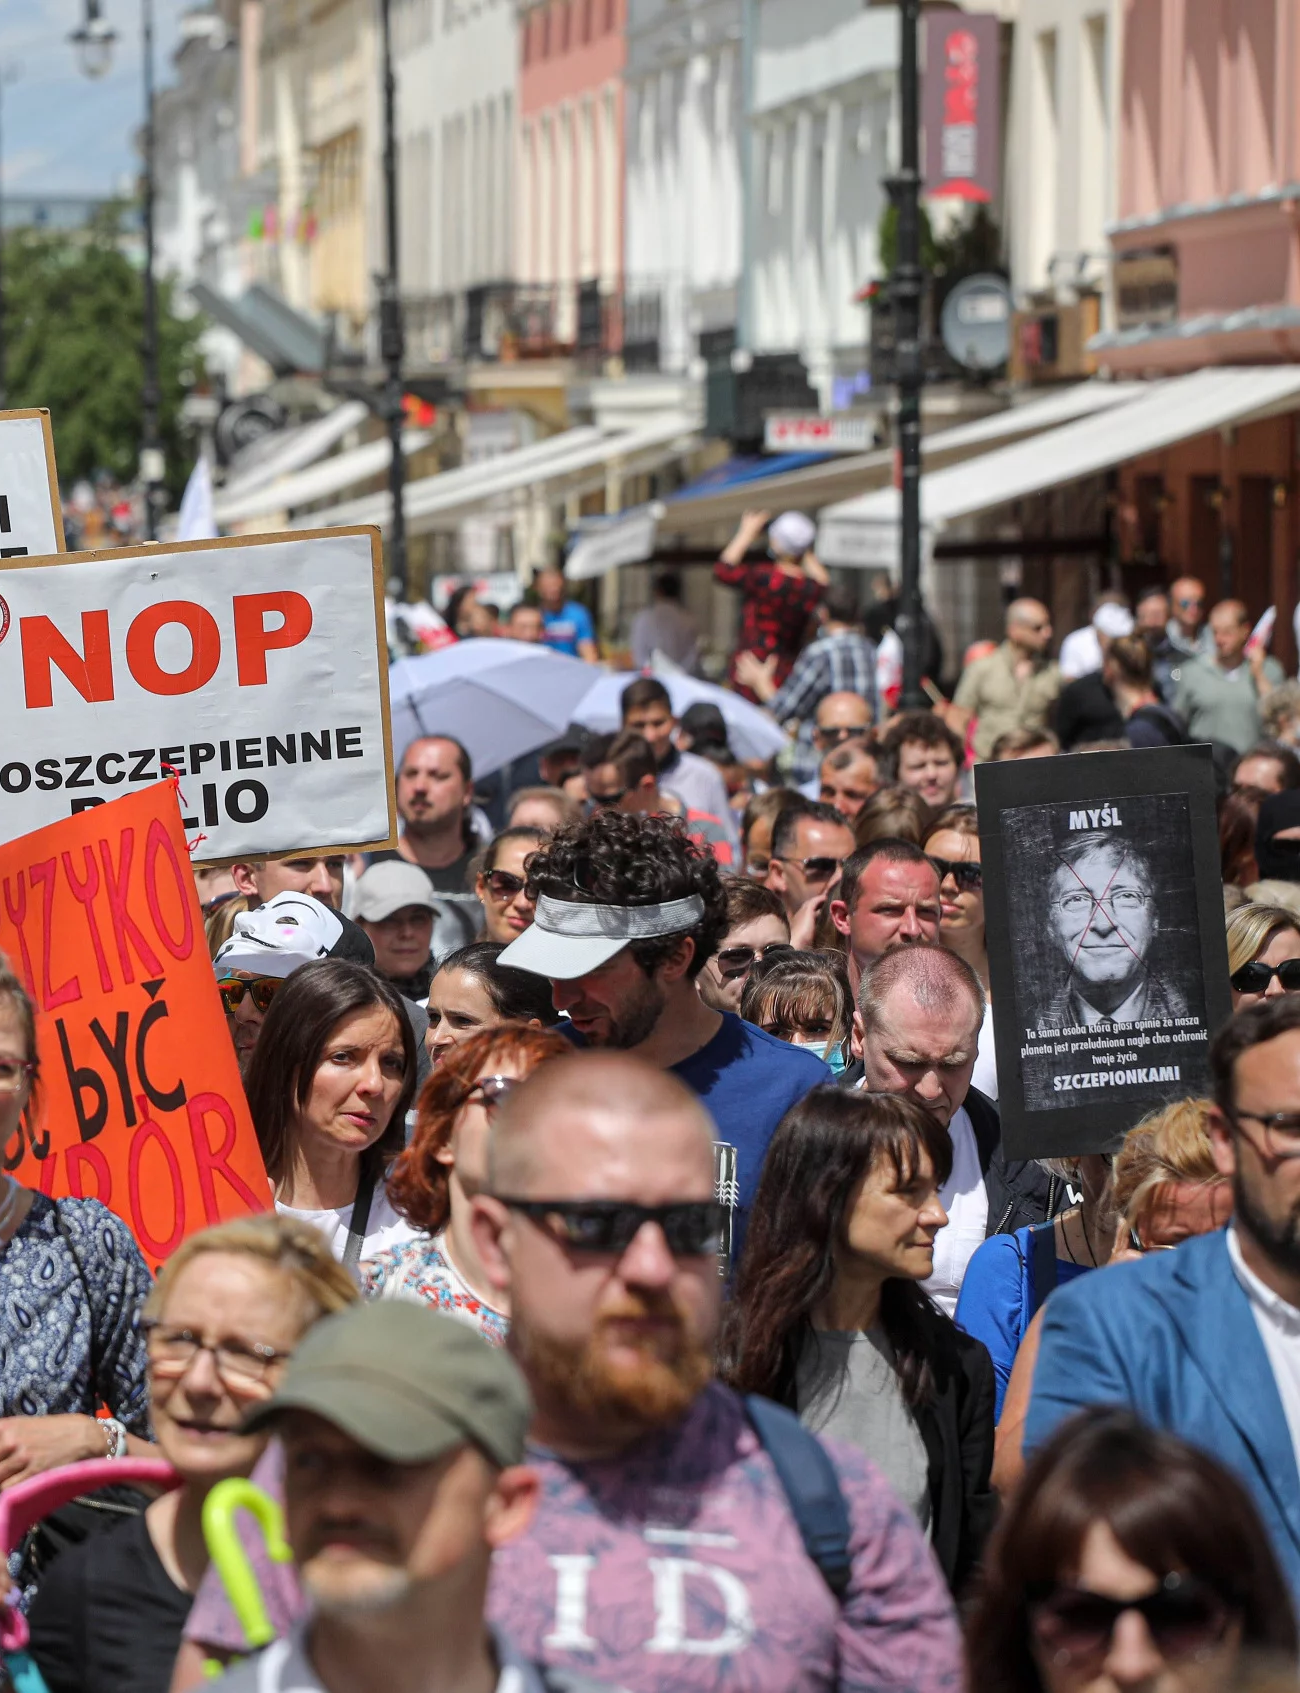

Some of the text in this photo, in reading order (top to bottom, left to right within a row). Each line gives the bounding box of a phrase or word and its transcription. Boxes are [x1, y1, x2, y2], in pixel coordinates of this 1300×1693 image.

[19, 590, 313, 709] NOP
[1069, 803, 1123, 830] MYŚL
[1026, 1029, 1036, 1039] Ta
[1038, 1028, 1060, 1038] sama
[1063, 1023, 1086, 1035] osoba
[1089, 1021, 1110, 1033] która
[1135, 1018, 1160, 1031] opinie
[1163, 1017, 1173, 1028] że
[1175, 1016, 1199, 1026] nasza
[1021, 1030, 1208, 1058] planeta jest przeludniona nagle chce ochronić
[1092, 1052, 1137, 1066] twoje życie
[1054, 1066, 1180, 1091] SZCZEPIONKAMI
